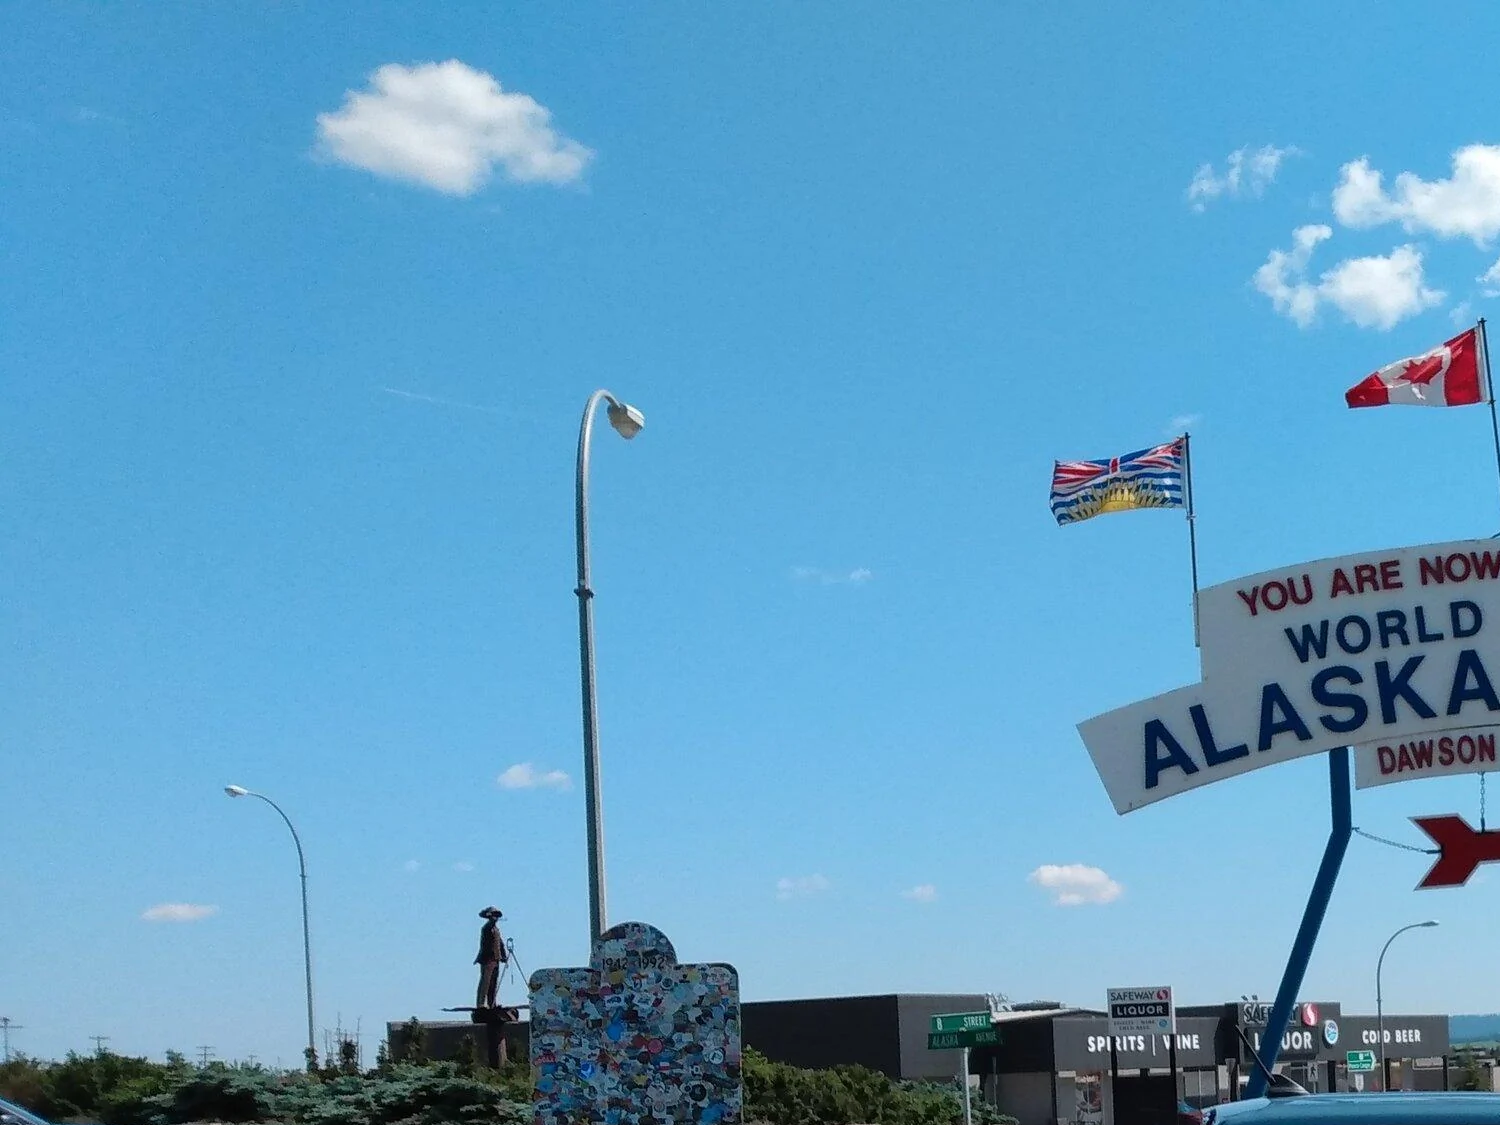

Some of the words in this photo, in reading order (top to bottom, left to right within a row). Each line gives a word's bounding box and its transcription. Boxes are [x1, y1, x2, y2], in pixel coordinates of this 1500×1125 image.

[1237, 574, 1314, 616] YOU
[1330, 559, 1404, 599] ARE
[1283, 599, 1483, 664] WORLD
[1377, 734, 1496, 775] DAWSON
[602, 957, 628, 970] 1942
[1110, 990, 1155, 1001] SAFEWAY
[1116, 1005, 1164, 1016] LIQUOR
[963, 1015, 987, 1028] STREET
[1087, 1035, 1145, 1053] SPIRITS
[1254, 1031, 1313, 1051] LUOR
[1395, 1029, 1421, 1043] BEER
